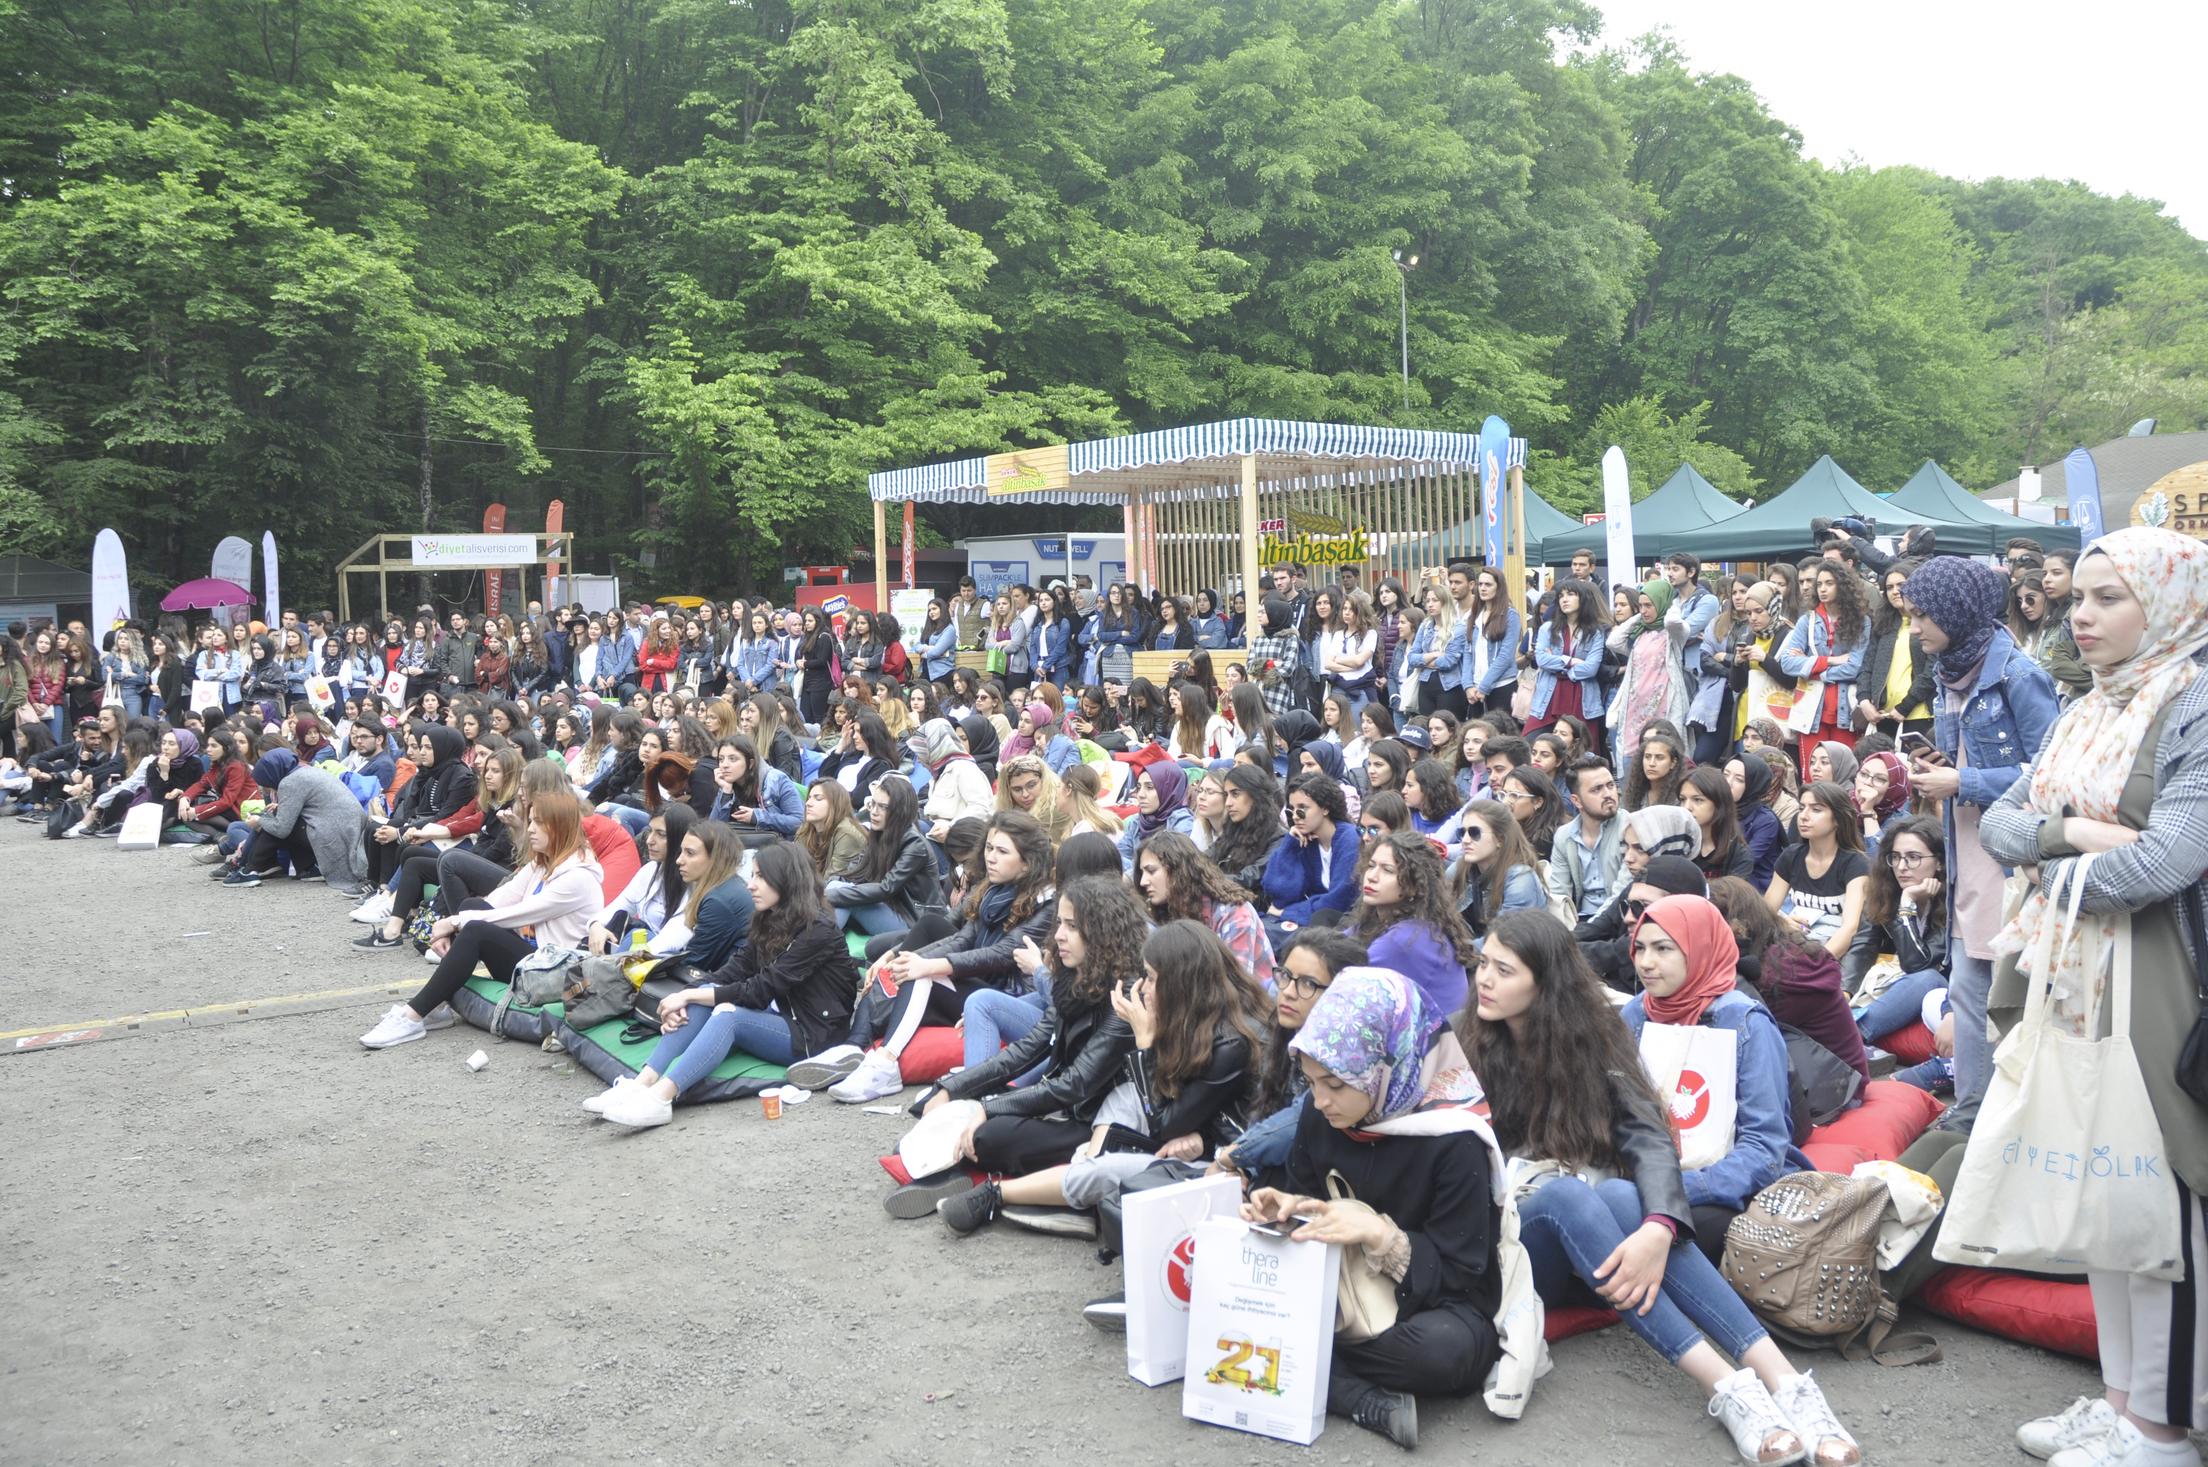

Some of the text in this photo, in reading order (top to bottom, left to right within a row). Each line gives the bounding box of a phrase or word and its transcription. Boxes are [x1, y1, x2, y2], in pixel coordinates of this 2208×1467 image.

[1242, 1246, 1279, 1269] thera
[1252, 1268, 1277, 1286] line
[1217, 1330, 1282, 1390] 21
